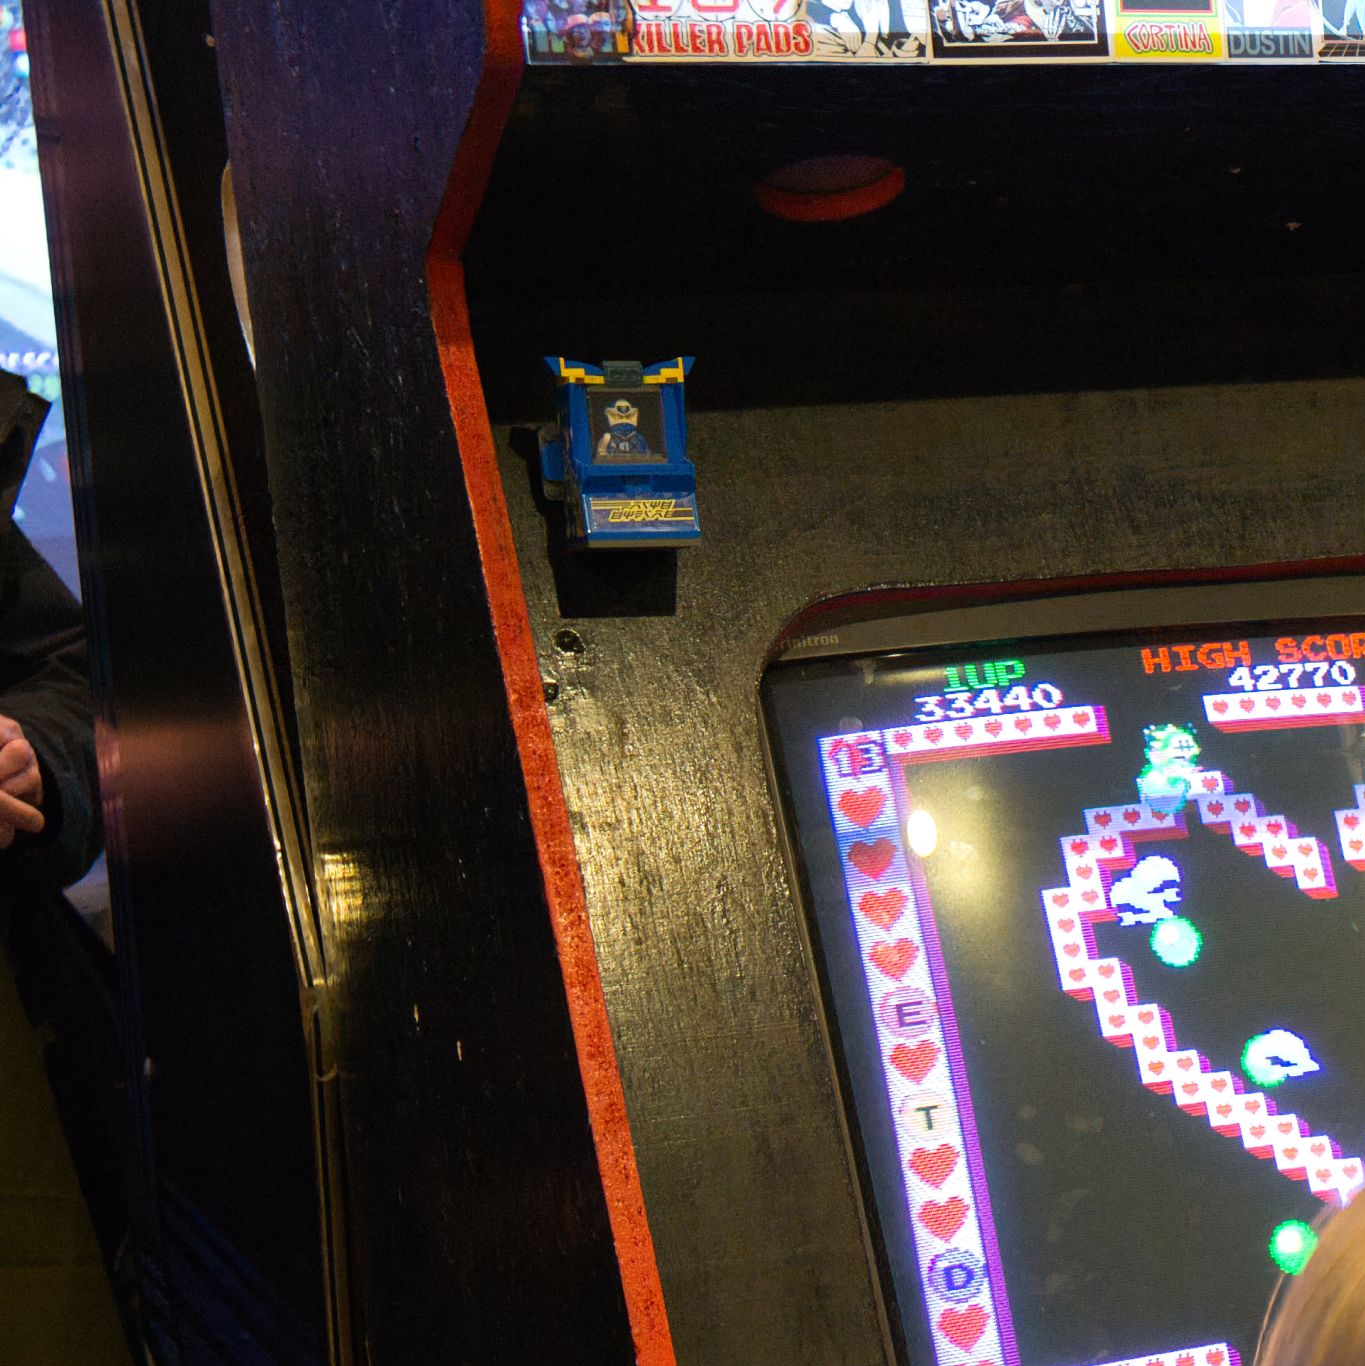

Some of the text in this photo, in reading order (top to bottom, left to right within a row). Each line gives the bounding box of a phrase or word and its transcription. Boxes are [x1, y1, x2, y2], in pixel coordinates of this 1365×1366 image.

[733, 20, 814, 57] PADS
[1229, 30, 1310, 55] DUSTIN
[1140, 640, 1252, 674] HIGH
[914, 682, 1065, 723] 33440
[1228, 660, 1357, 692] 42770
